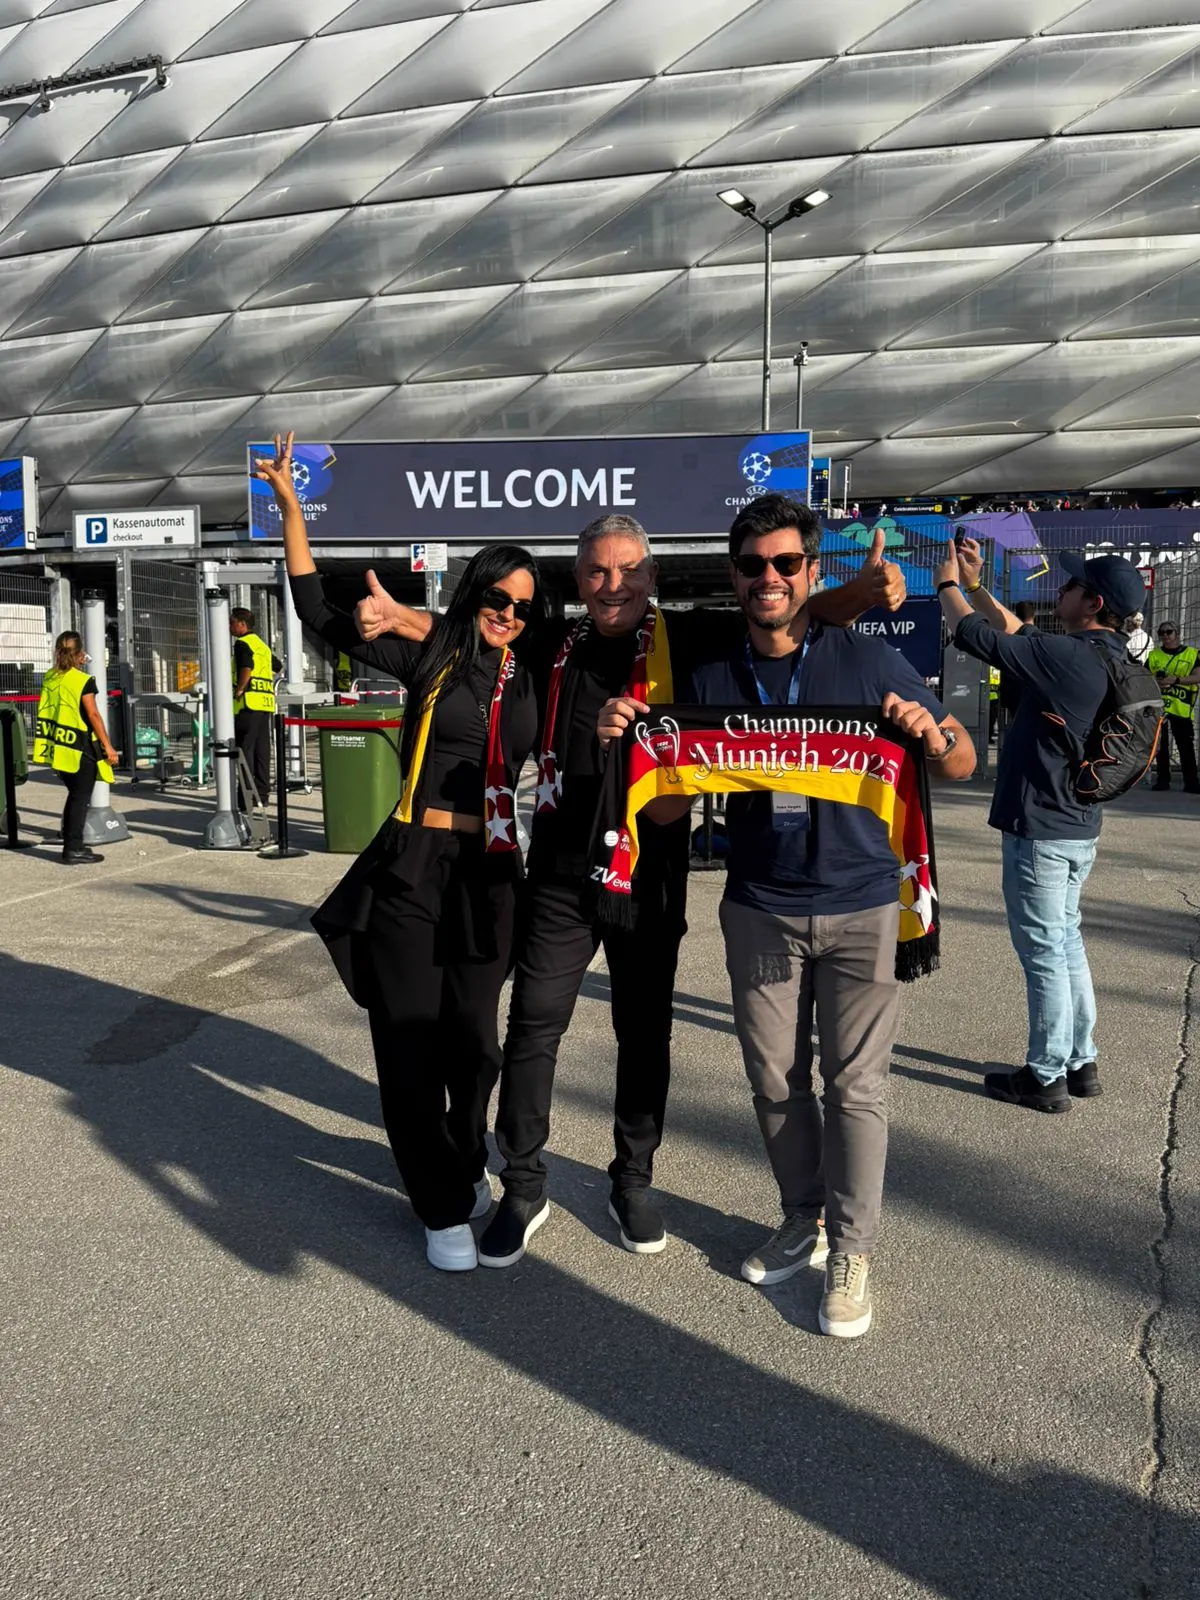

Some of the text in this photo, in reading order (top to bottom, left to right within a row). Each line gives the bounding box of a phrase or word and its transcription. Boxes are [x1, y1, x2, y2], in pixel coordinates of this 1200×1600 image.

[406, 467, 636, 509] WELCOME
[747, 486, 767, 496] UEFA
[268, 503, 328, 512] CHIONS
[90, 517, 185, 541] P Kassenautomat
[113, 533, 143, 541] checkout
[891, 621, 915, 635] VIP
[723, 713, 878, 742] Champions
[689, 740, 899, 786] Munich 2025
[590, 865, 618, 884] ZV
